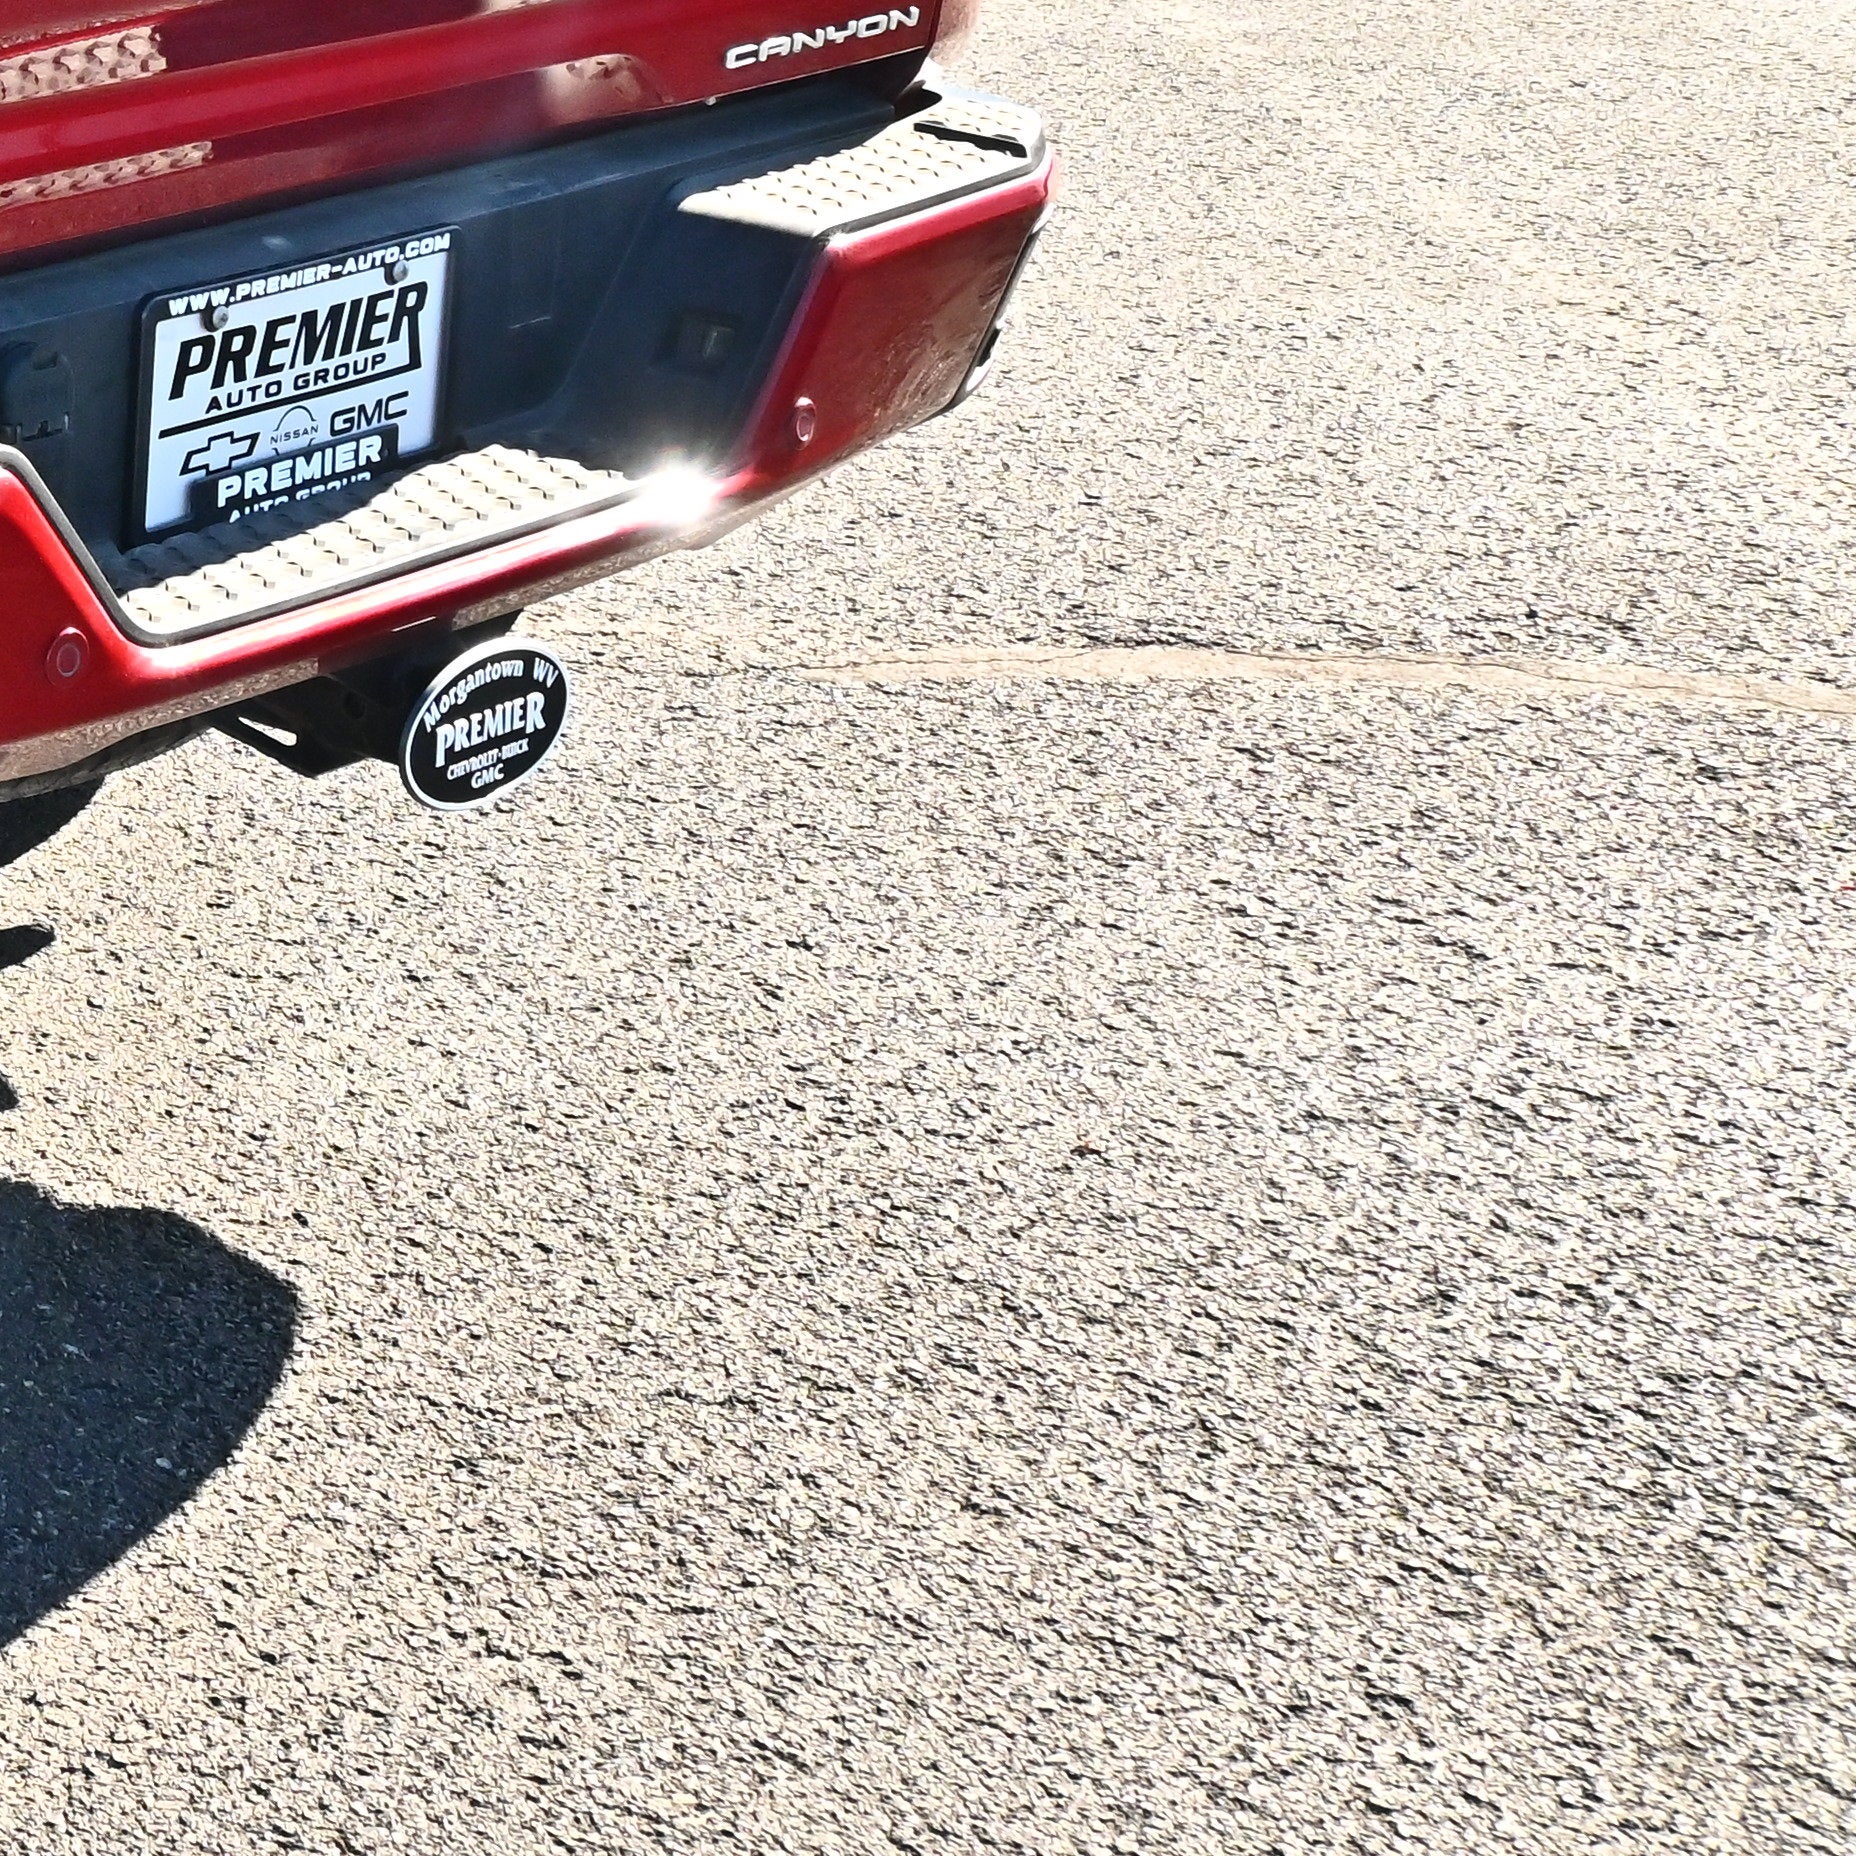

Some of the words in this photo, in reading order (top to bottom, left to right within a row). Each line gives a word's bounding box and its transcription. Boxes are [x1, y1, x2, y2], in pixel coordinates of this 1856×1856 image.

[725, 5, 920, 70] CANYON
[168, 232, 451, 317] WWW.PREMIER-AUTO.COM
[168, 281, 429, 401] PREMIER
[205, 383, 283, 414] AUTO
[293, 352, 387, 391] GROUP
[329, 390, 410, 436] GMC
[270, 425, 319, 445] NISSAN
[217, 435, 381, 508] PREMIER
[422, 659, 524, 733] Morgantown
[533, 657, 559, 689] WV
[435, 692, 546, 768] PREMIER
[471, 763, 505, 789] GMC
